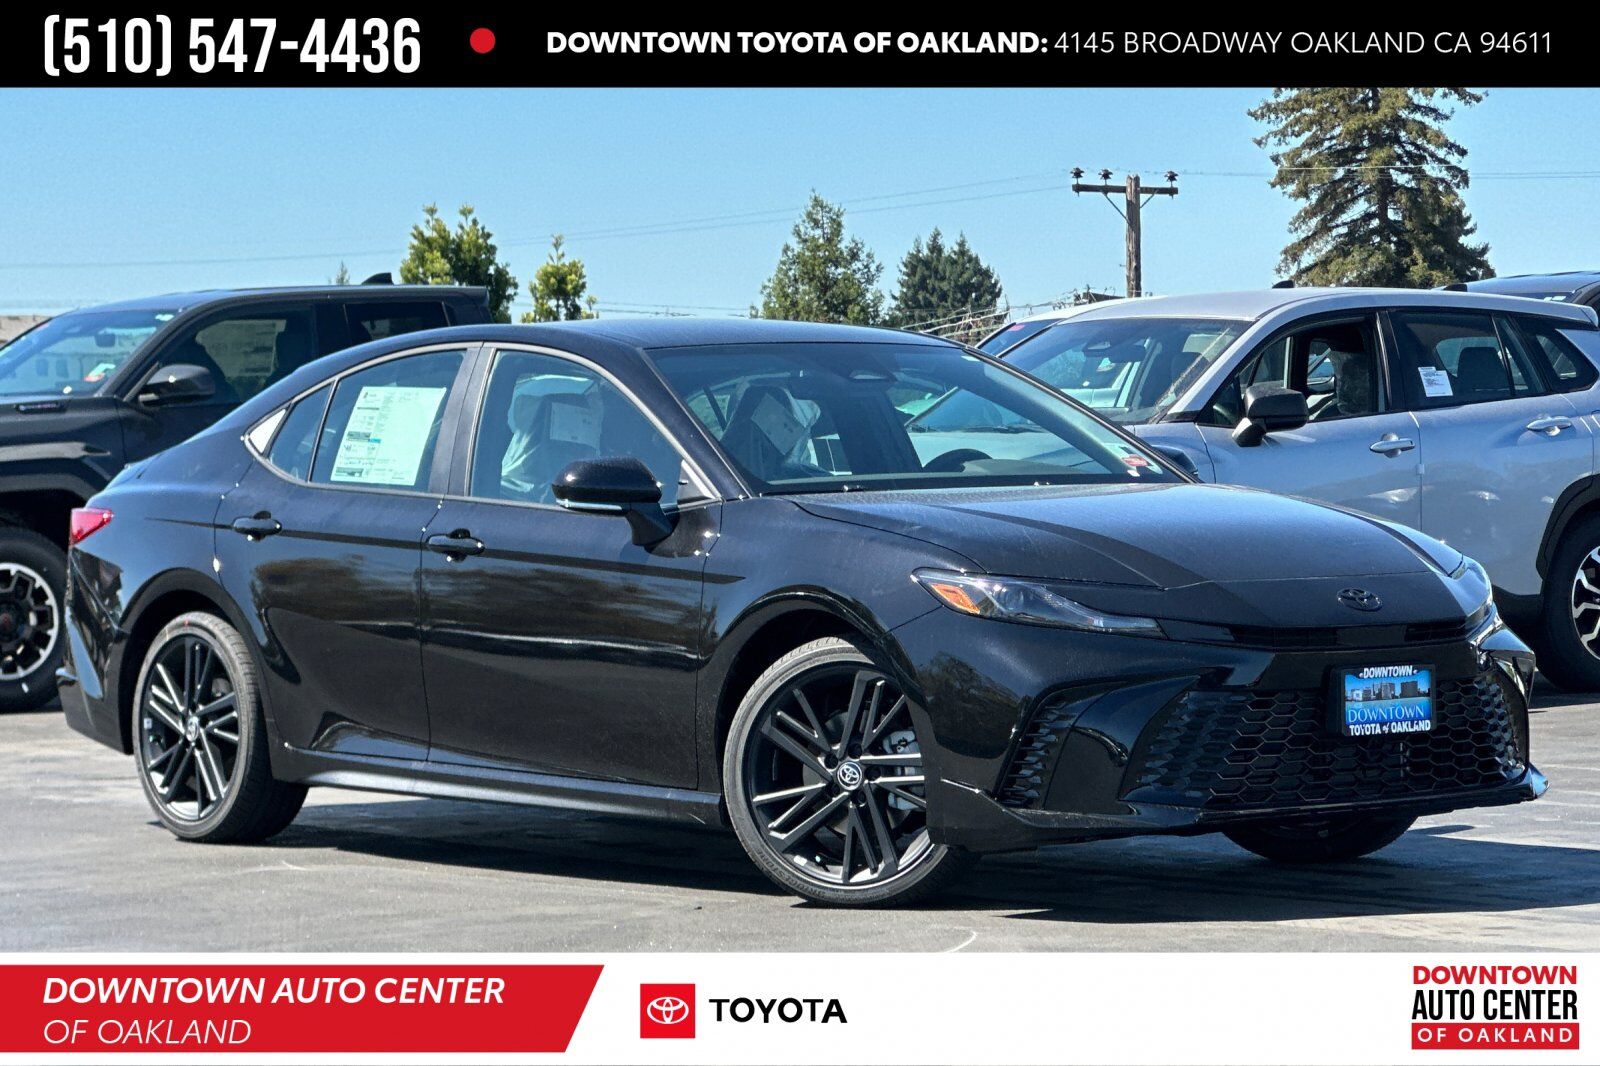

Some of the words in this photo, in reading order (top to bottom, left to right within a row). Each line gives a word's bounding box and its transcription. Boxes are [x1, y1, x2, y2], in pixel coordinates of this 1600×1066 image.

[1363, 665, 1413, 679] DOWNTOWN
[1348, 705, 1425, 723] DOWNTOWN
[1349, 724, 1381, 736] TOYOTA
[1391, 720, 1431, 733] OAKLAND
